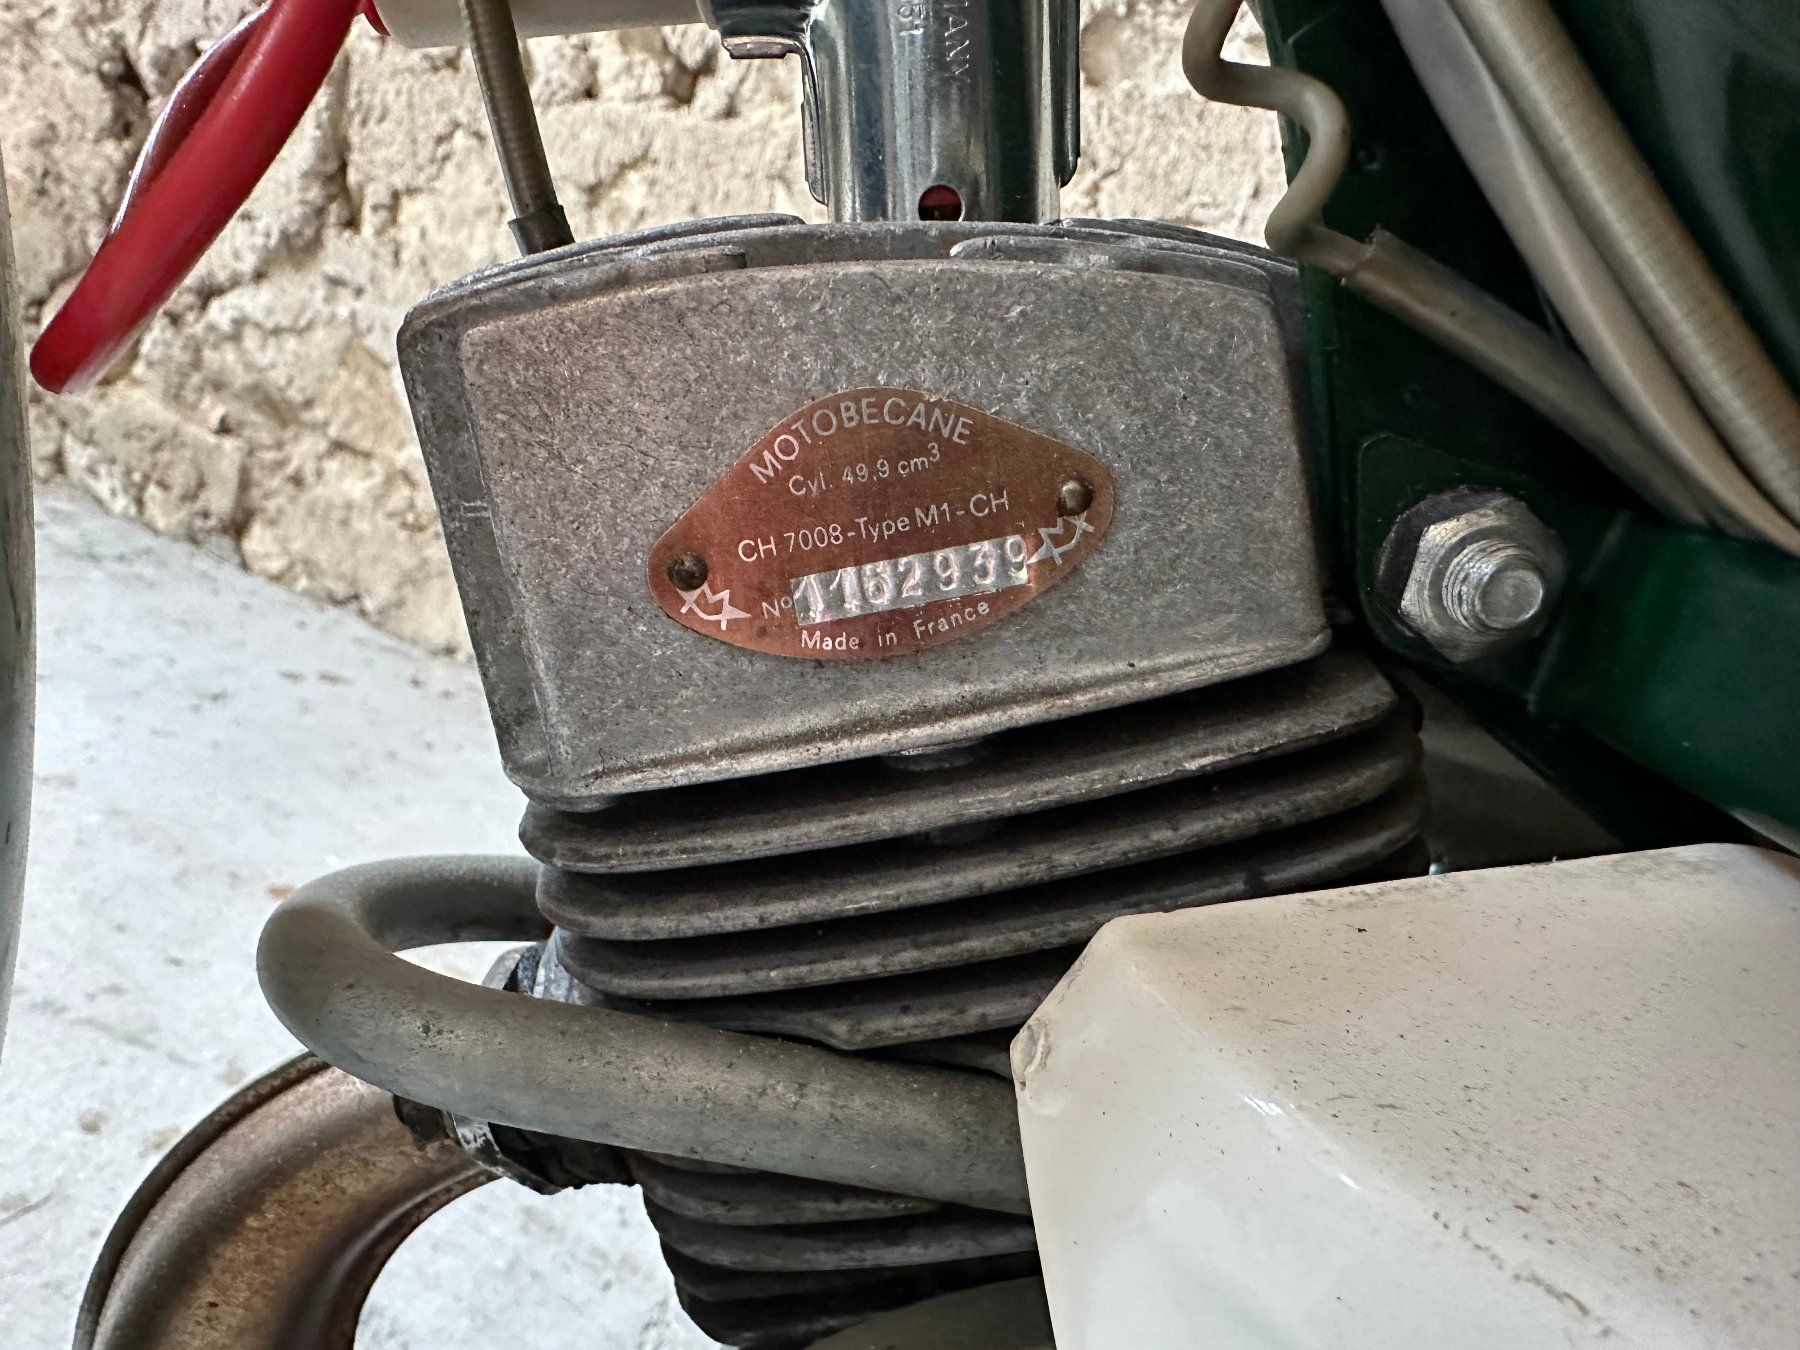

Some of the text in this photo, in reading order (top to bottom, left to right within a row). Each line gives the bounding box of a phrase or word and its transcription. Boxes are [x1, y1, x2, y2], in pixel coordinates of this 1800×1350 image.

[749, 397, 974, 484] MOTOBECANE
[788, 471, 833, 497] Cyl.
[737, 536, 777, 562] CH
[801, 601, 991, 651] Made in France
